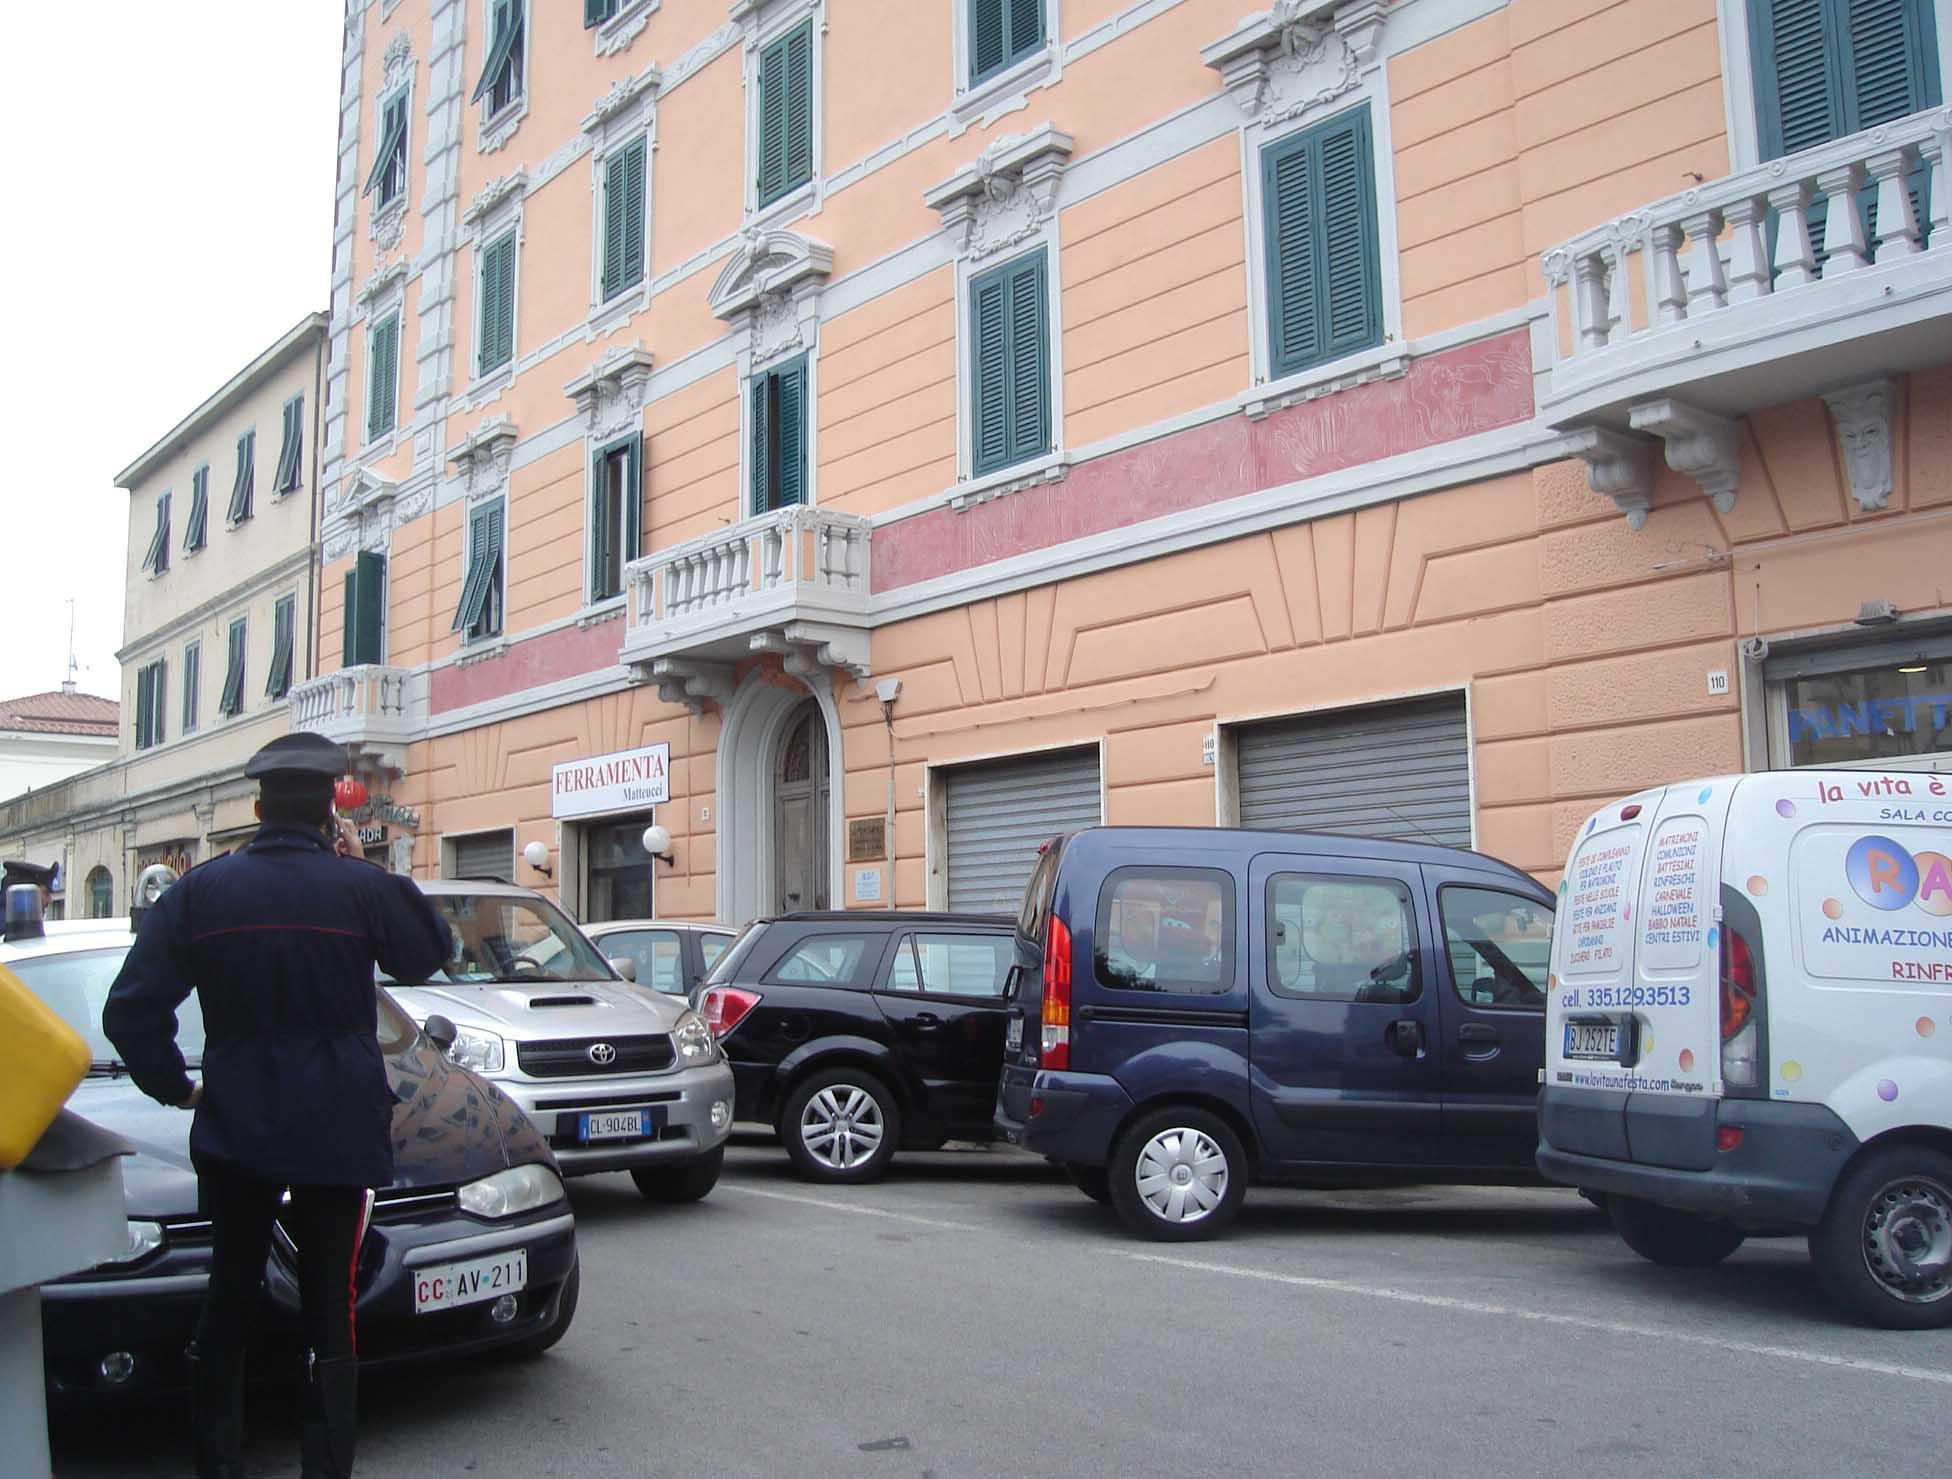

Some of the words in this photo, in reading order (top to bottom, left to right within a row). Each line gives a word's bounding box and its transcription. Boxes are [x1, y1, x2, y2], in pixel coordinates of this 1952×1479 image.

[1711, 675, 1725, 689] 110
[555, 753, 665, 795] FERRAMENTA
[623, 782, 663, 802] Matteucci
[1818, 781, 1844, 804] la
[1857, 776, 1912, 797] vita
[1928, 775, 1946, 796] è
[1879, 808, 1926, 822] SALA
[1656, 859, 1695, 874] BATTESIMI
[1654, 873, 1697, 888] RINFRESCHI
[1654, 888, 1693, 903] CARNEVALE
[1652, 902, 1694, 917] HALLOWEEN
[1648, 918, 1669, 931] BABBO
[1669, 915, 1698, 929] NATALE
[1645, 931, 1670, 945] CENTRI
[1672, 930, 1701, 944] ESTIVI
[1562, 988, 1582, 1008] cell.
[1587, 986, 1691, 1007] 335.129.3513
[1585, 1027, 1617, 1053] 252TE
[418, 1277, 444, 1304] CC
[457, 1269, 481, 1297] AV
[491, 1260, 523, 1289] 211
